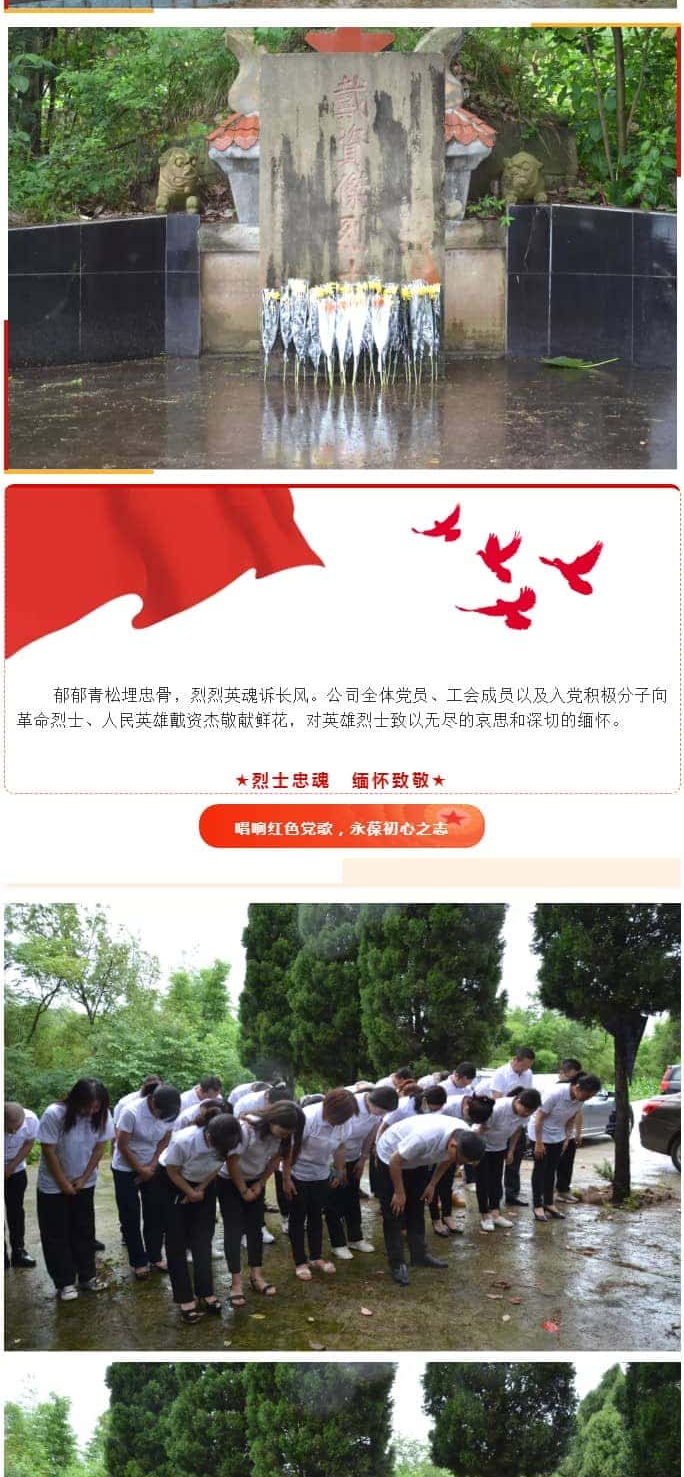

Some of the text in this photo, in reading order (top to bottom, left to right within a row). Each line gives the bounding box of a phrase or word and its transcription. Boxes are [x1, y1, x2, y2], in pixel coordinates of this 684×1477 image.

[252, 772, 429, 789] 烈士忠魂 缅怀致敬
[234, 820, 449, 837] 唱响红色党歌，永葆初心之志
